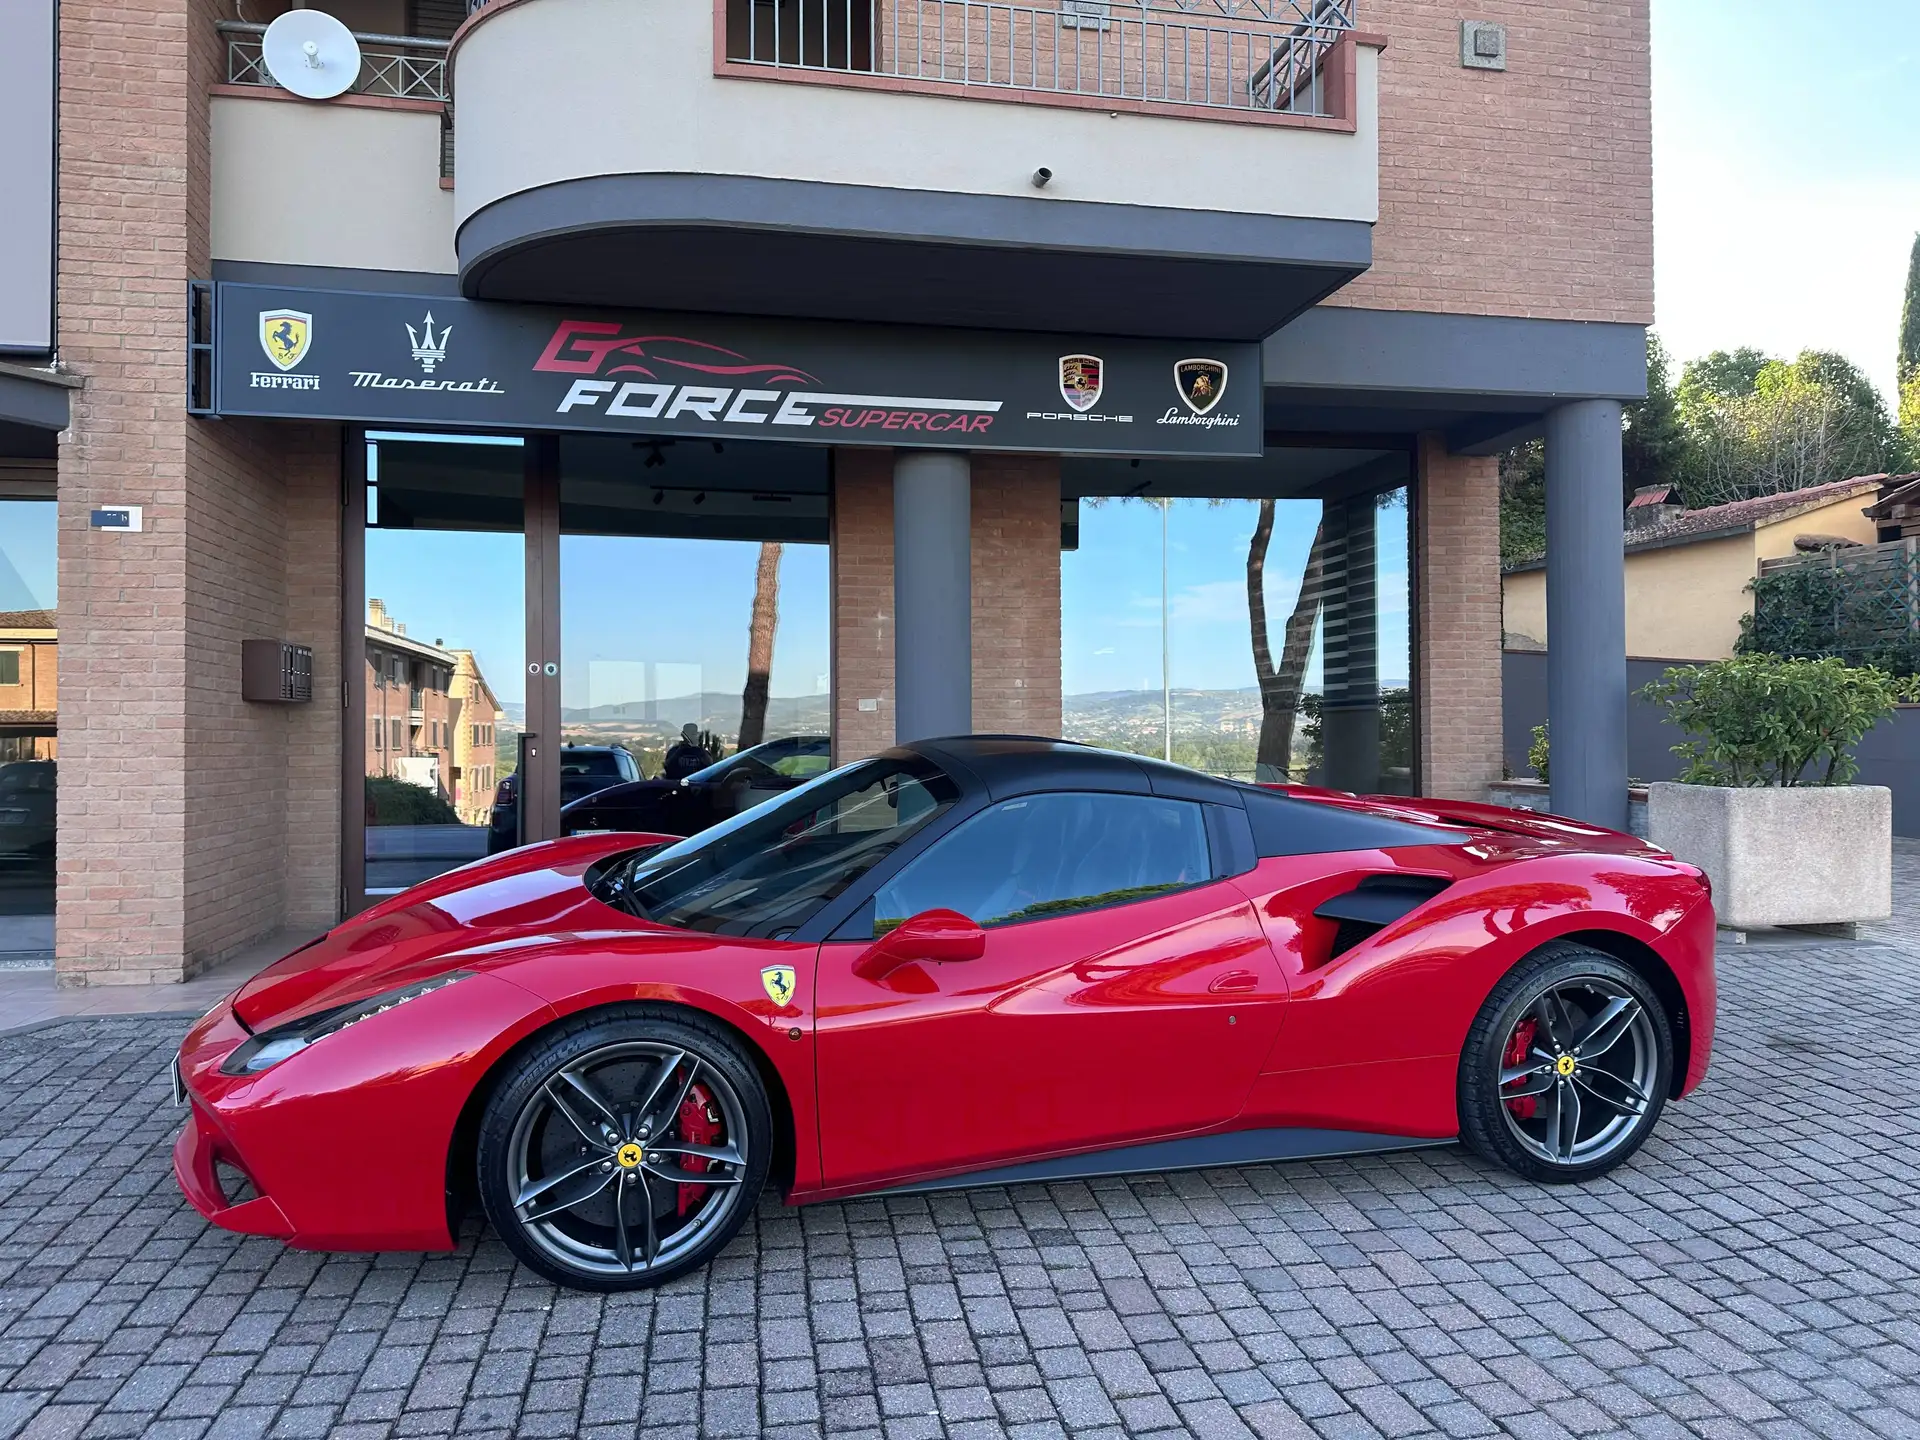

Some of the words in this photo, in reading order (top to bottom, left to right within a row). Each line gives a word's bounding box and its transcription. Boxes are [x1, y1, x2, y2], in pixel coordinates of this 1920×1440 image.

[1180, 364, 1221, 373] LAMBORGHINI
[250, 371, 321, 390] Ferrari
[349, 371, 505, 393] Maserati
[556, 378, 817, 425] FORCE
[817, 407, 995, 434] SUPERCAR
[1026, 411, 1134, 423] PORSCHE
[1156, 406, 1241, 430] Lamborghini
